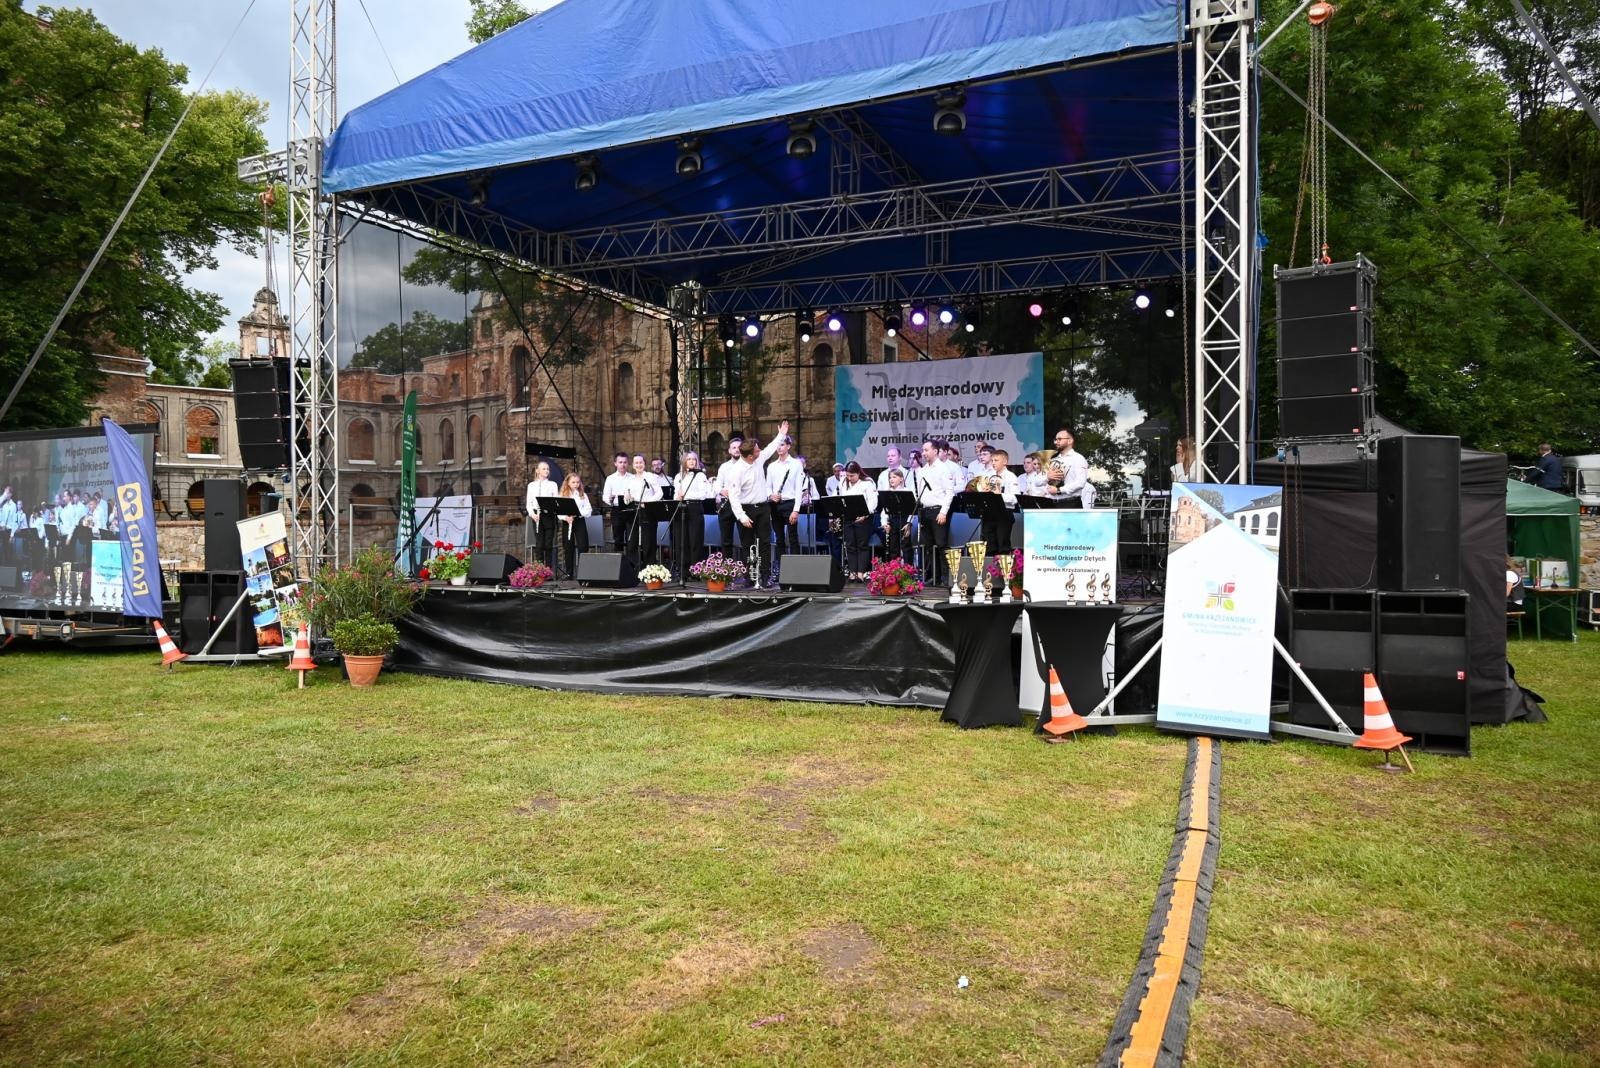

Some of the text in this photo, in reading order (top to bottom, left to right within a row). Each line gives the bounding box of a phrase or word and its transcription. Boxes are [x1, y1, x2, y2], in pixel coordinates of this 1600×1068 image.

[871, 380, 1005, 401] Międzynarodowy
[841, 402, 1036, 423] Festiwal Orkiestr Dętych
[868, 435, 878, 445] w
[880, 433, 919, 447] gminie
[1043, 544, 1096, 552] Międzynarodowy
